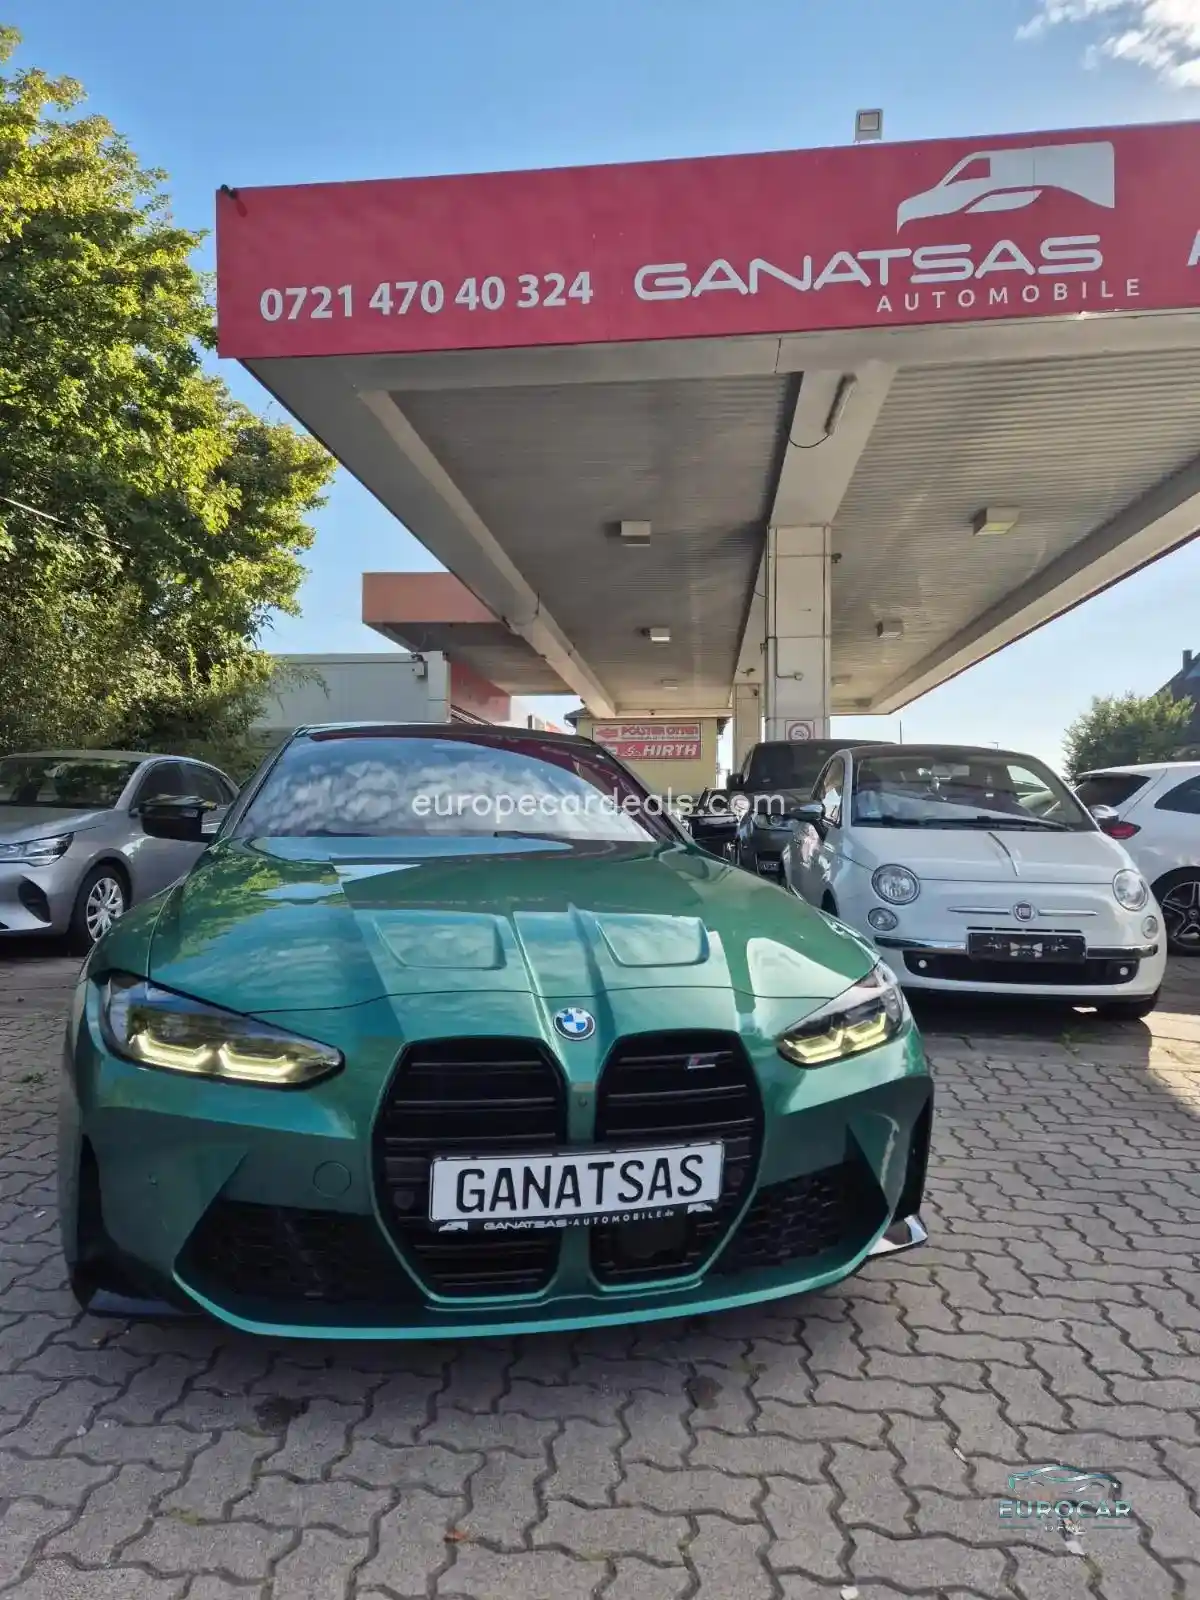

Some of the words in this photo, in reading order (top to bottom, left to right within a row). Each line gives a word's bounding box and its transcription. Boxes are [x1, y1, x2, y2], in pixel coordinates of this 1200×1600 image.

[634, 234, 1104, 301] GANATSAS
[260, 284, 353, 322] 0721
[369, 279, 445, 316] 470
[455, 275, 506, 312] 40
[517, 271, 594, 308] 324
[876, 278, 1141, 313] AUTOMOBILE
[643, 743, 698, 757] HIRTH
[455, 1153, 704, 1214] GANATSAS
